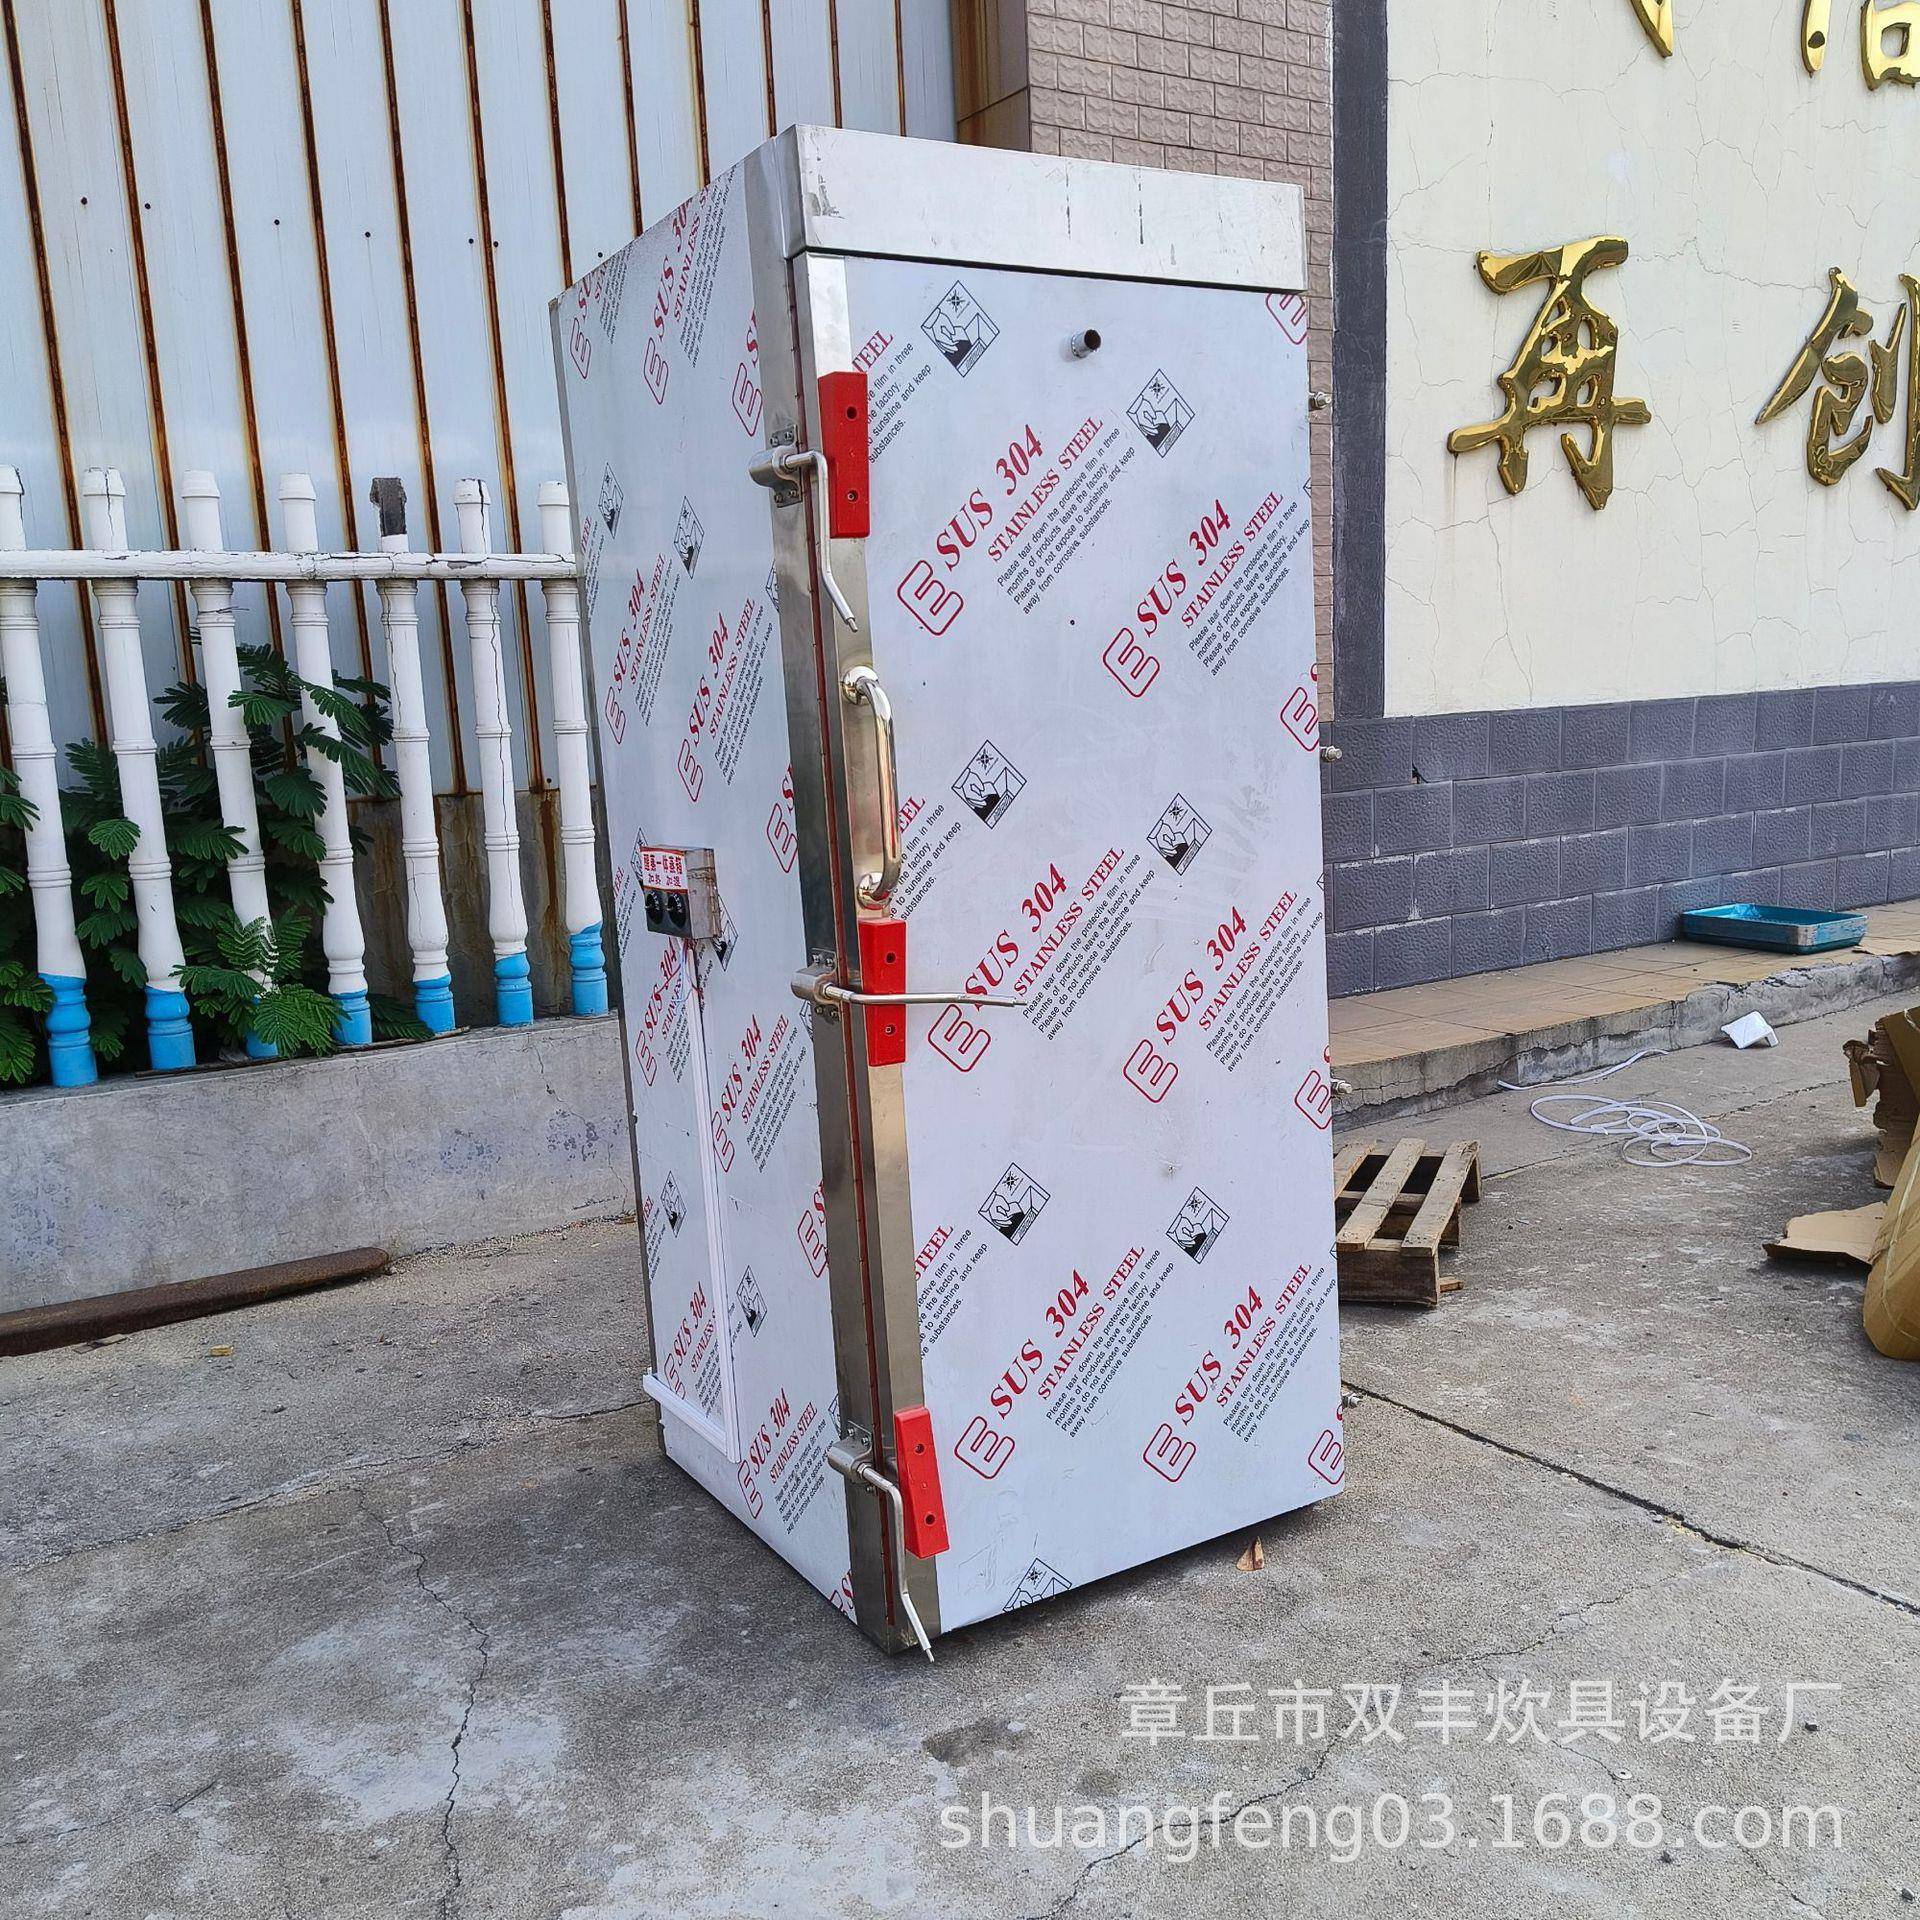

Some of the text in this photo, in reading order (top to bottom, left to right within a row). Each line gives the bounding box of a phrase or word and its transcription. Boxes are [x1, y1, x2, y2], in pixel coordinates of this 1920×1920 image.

[653, 253, 674, 342] SUS
[674, 213, 699, 323] STAINLESS
[852, 330, 894, 372] TEEL
[936, 423, 1043, 572] SUS 304
[987, 416, 1103, 563] STAINLESS STEEL
[996, 427, 1120, 587] Please tear down the protective film in three
[1006, 567, 1029, 596] months
[1028, 555, 1036, 567] of
[1035, 524, 1061, 560] products
[1058, 503, 1078, 525] leave
[1075, 489, 1088, 504] the
[1012, 446, 1135, 605] Please do not expose to sunshine and keep
[896, 559, 964, 636] E
[1022, 498, 1112, 614] away from corrosive substances.
[1136, 498, 1231, 638] SUS 304
[1181, 490, 1283, 629] STAINLESS STEEL
[1188, 500, 1298, 651] Please tear down the protective film in three
[1196, 632, 1217, 660] months
[1216, 621, 1224, 632] of
[1222, 592, 1245, 625] products
[1243, 572, 1260, 593] leave
[1258, 559, 1269, 573] the
[1202, 518, 1310, 668] Please do not expose to sunshine and keep
[613, 567, 645, 695] SUS 304
[630, 552, 666, 686] STAINLESS STEEL
[689, 611, 729, 748] SUS 304
[709, 596, 755, 740] STAINLESS STEEL
[1102, 626, 1160, 698] E
[1210, 567, 1290, 676] away from corrosive substances.
[604, 685, 626, 745] E
[677, 737, 703, 803] E
[897, 796, 926, 833] EEL
[964, 863, 1067, 1012] SUS 304
[1013, 847, 1124, 997] STAINLESS STEEL
[1155, 905, 1247, 1046] SUS 304
[1198, 890, 1297, 1032] STAINLESS STEEL
[721, 1013, 762, 1125] SUS 304
[741, 1012, 789, 1126] STAINLESS STEEL
[927, 1003, 991, 1073] E
[1122, 1038, 1179, 1104] E
[673, 1280, 706, 1369] SUS 304
[990, 1269, 1089, 1420] SUS 304
[1037, 1246, 1145, 1400] STAINLESS STEEL
[1045, 1249, 1160, 1420] Please tear down the protective film in three
[1054, 1396, 1076, 1426] months
[1074, 1384, 1082, 1395] of
[1081, 1350, 1105, 1386] products
[1103, 1327, 1121, 1349] leave
[1118, 1312, 1130, 1326] the
[1060, 1262, 1174, 1432] Please do not expose to sunshine and keep
[1069, 1314, 1153, 1438] away from corrosive substances.
[1174, 1285, 1263, 1427] SUS 304
[1216, 1264, 1311, 1408] STAINLESS STEEL
[749, 1386, 791, 1477] SUS 304
[770, 1399, 818, 1485] STAINLESS STEEL
[953, 1415, 1016, 1480] E
[1142, 1422, 1197, 1483] E
